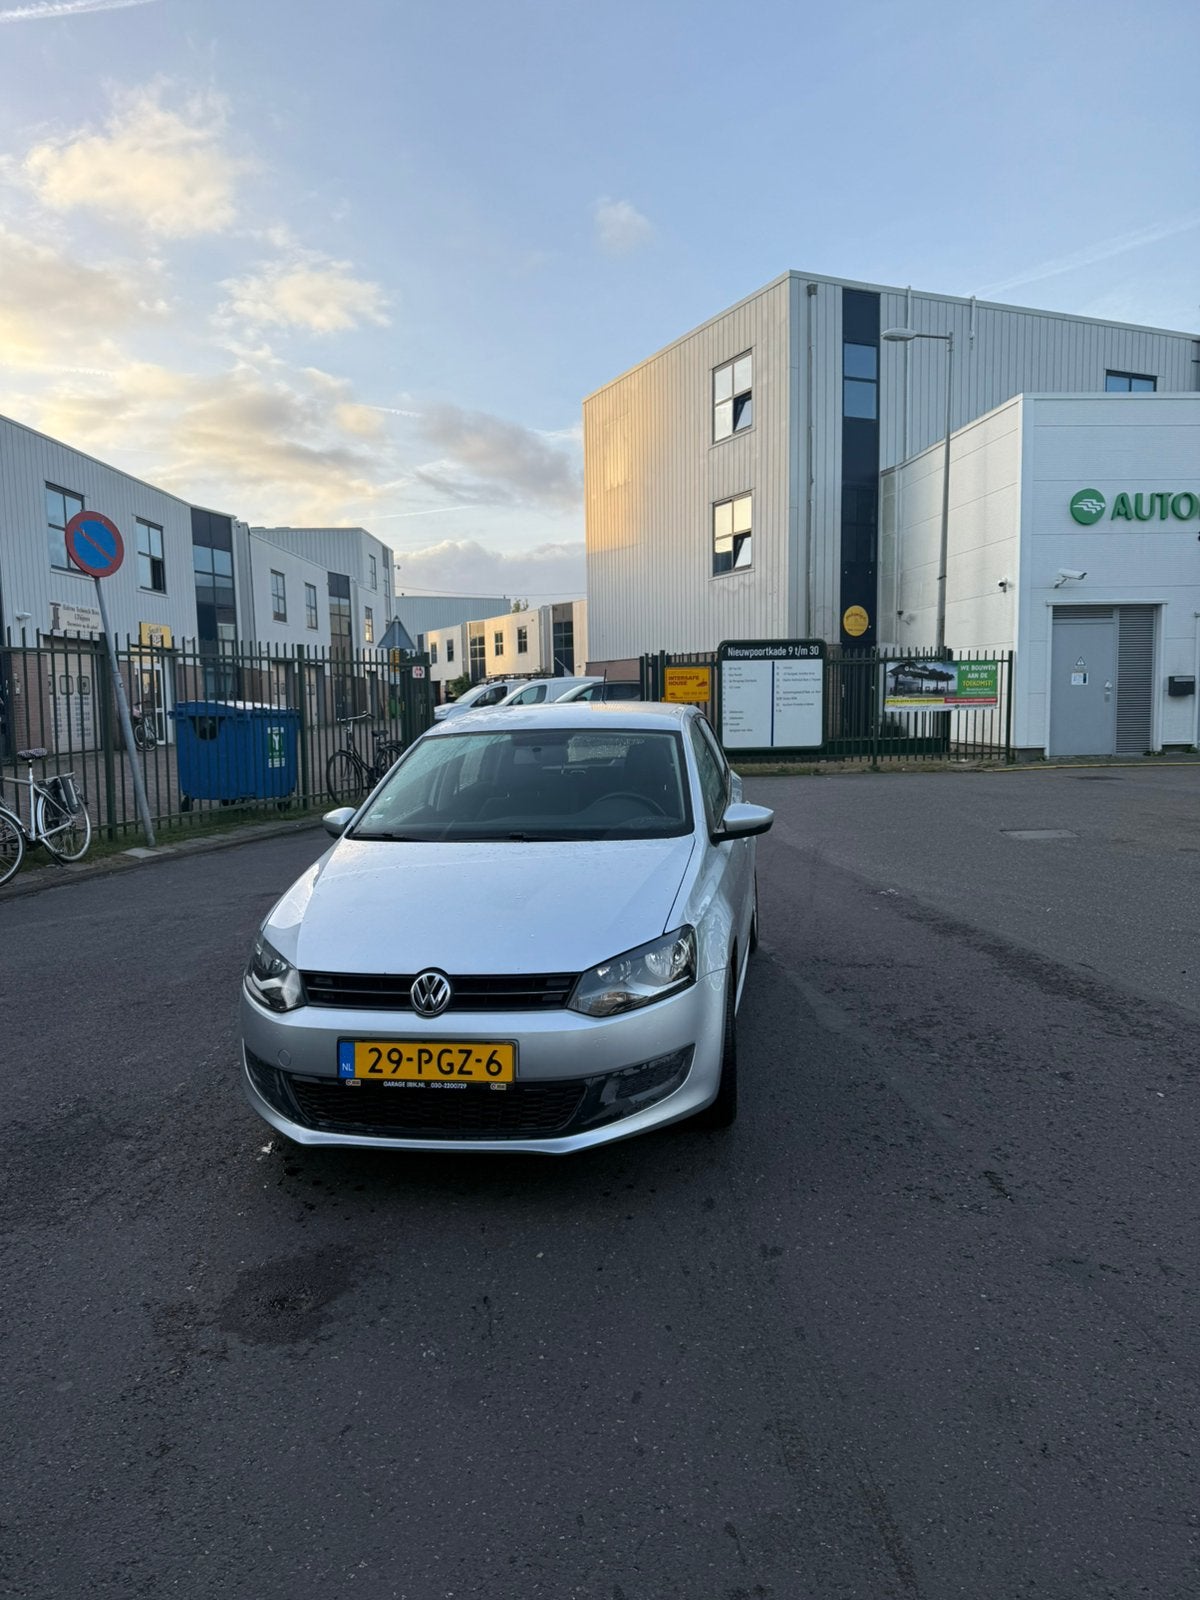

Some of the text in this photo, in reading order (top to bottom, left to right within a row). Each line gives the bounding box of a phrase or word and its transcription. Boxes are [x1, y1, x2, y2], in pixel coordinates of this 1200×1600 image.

[1110, 492, 1200, 521] AUTO
[727, 645, 819, 658] Nieuwpoortkade 9 t/m 30
[341, 1063, 353, 1072] NL
[368, 1047, 503, 1077] 29-PGZ-6
